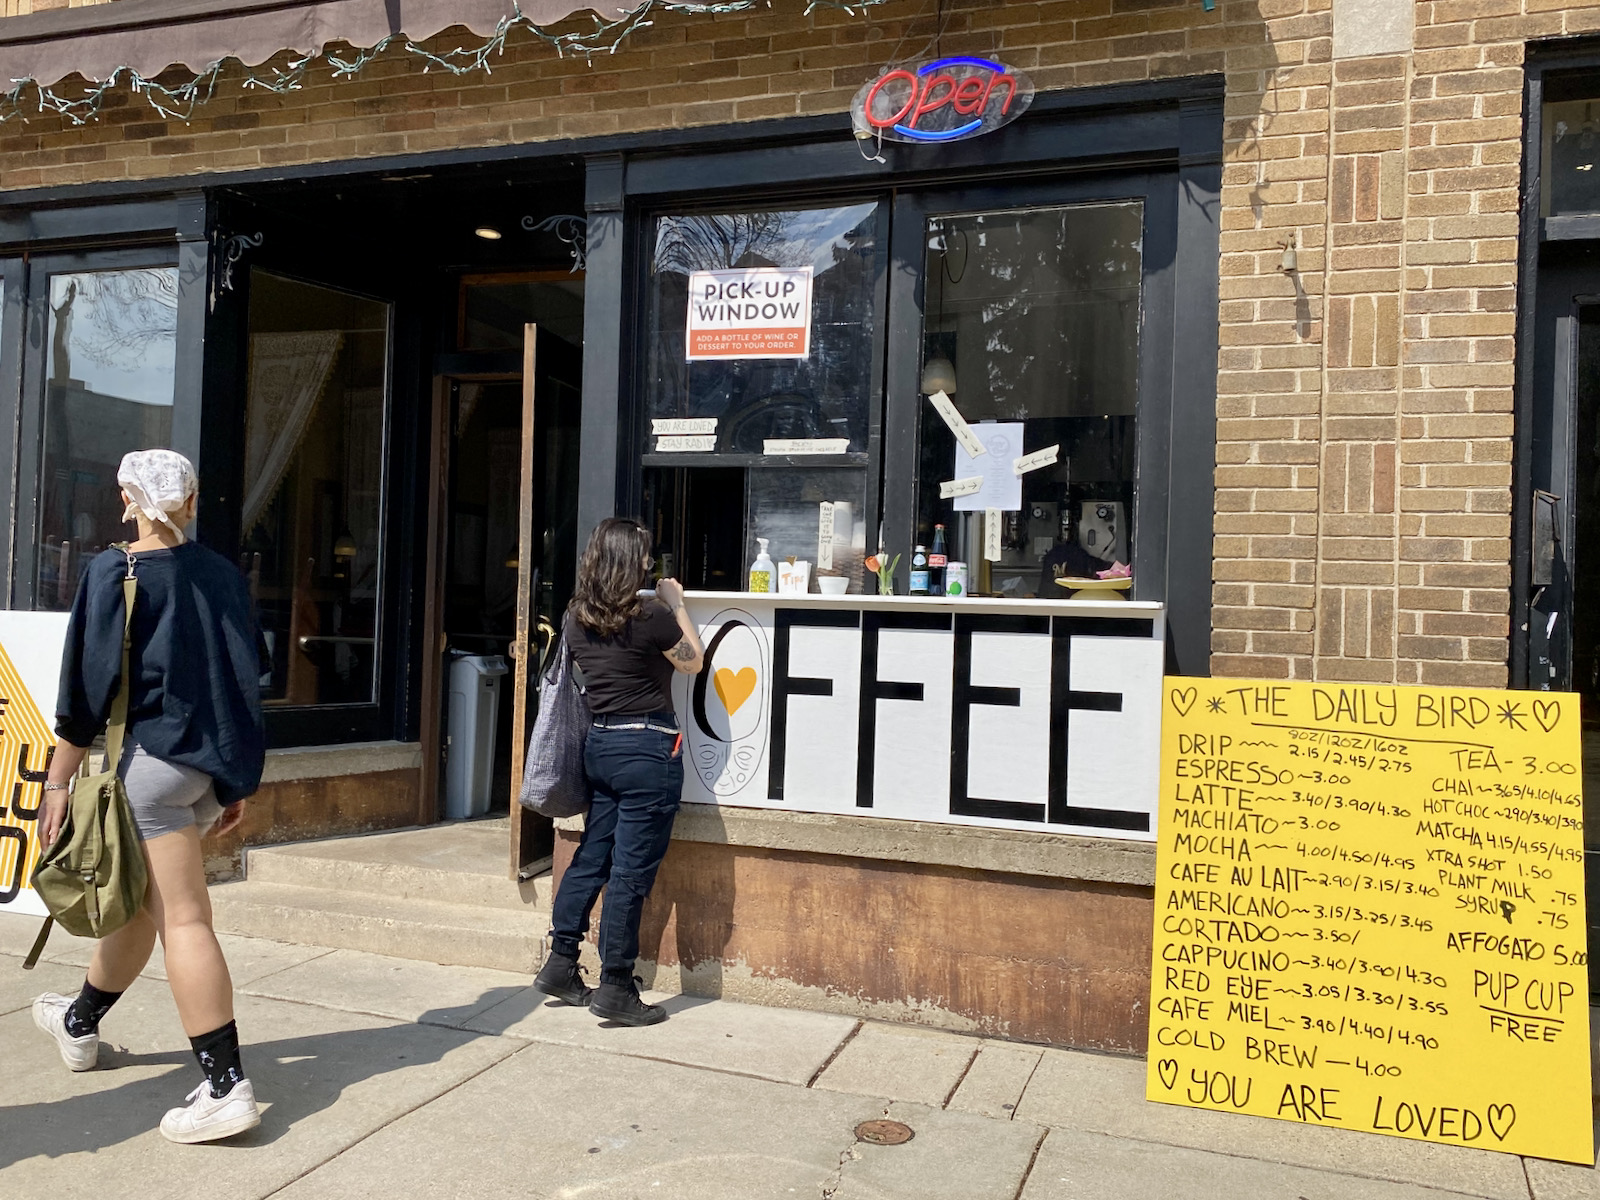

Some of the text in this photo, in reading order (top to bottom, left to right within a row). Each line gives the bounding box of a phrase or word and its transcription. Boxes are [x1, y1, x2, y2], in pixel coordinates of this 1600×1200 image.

[864, 69, 1018, 129] Open
[704, 281, 796, 301] PICK-UP
[698, 302, 801, 322] WINDOW
[696, 335, 713, 343] ADD
[722, 334, 749, 342] BOTTLE
[752, 333, 763, 341] OF
[764, 333, 785, 341] WINE
[787, 332, 799, 340] OR
[698, 342, 729, 351] DESSERT
[732, 342, 742, 350] TO
[744, 341, 765, 349] YOUR
[657, 420, 714, 433] YOU ARE LOVED
[662, 438, 682, 449] STAY
[1226, 687, 1490, 729] THE DAILY BIRD
[1178, 733, 1232, 756] DRIP
[1176, 758, 1351, 785] ESPRESSO 3.00
[1522, 757, 1577, 775] 3.00
[1175, 783, 1412, 818] LATTE 3.40/3.90/4.30
[1432, 778, 1474, 796] CHAI
[1173, 808, 1341, 834] MACHIATO 3.00
[1424, 798, 1454, 813] HOT
[1456, 801, 1491, 819] CHOC
[1173, 833, 1416, 870] MOCHA 4.00/4.50/4.95
[1416, 821, 1583, 863] MATCHA 4.15/4.55/4.95
[1426, 849, 1553, 879] XTRA SHOT 1.50
[1170, 863, 1440, 898] CAFE AU LAIT 2.90/3.15/3.40
[1438, 869, 1488, 890] PLANT
[1491, 879, 1536, 904] MILK
[1167, 890, 1434, 932] AMERICANO 3.15/3.25/3.45
[1455, 894, 1517, 925] SYRUP
[1163, 916, 1280, 943] CORTADO
[1447, 932, 1588, 966] AFFOGATO 5.00
[1162, 943, 1448, 988] CAPPUCINO 3.40/3.90/4.30
[1166, 966, 1449, 1016] RED EYE 3.05/3.30/3.55
[1474, 969, 1574, 1014] PUP CUP
[1157, 996, 1440, 1050] CAFE MIEL 3.90/4.40/4.90
[1490, 1015, 1563, 1043] FREE
[1157, 1027, 1402, 1077] COLD BREW 4.00
[1187, 1068, 1483, 1141] YOU ARE LOVED
